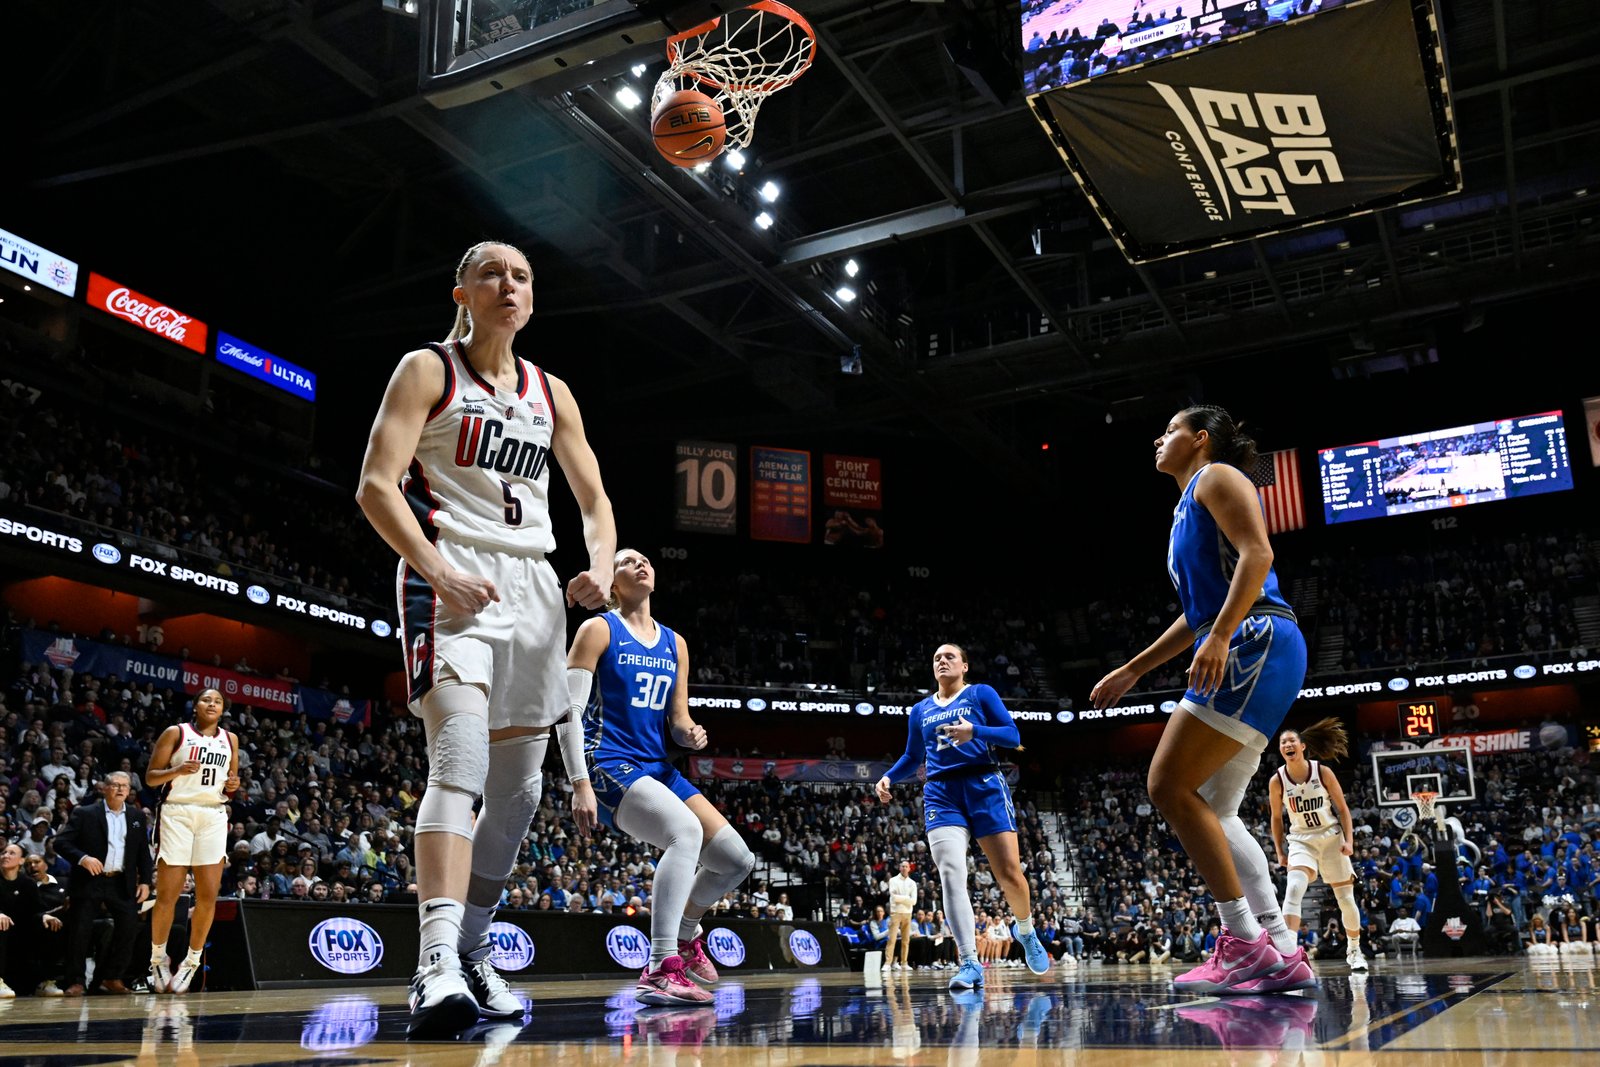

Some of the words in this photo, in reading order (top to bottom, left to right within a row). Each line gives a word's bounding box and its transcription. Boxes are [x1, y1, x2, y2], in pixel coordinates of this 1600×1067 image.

[1244, 1, 1257, 12] 42
[1175, 22, 1186, 32] 22
[1254, 93, 1344, 184] BIG
[1188, 87, 1296, 215] EAST
[1165, 130, 1223, 222] CONFERENCE
[106, 288, 191, 341] Coca-Cola
[219, 342, 263, 367] Michelob
[273, 364, 312, 391] ULTRA
[455, 415, 548, 481] UConn
[676, 445, 704, 457] BILLY
[707, 448, 735, 460] JOEL
[758, 461, 789, 471] ARENA
[791, 464, 803, 472] OF
[835, 459, 870, 472] FIGHT
[675, 458, 736, 510] 10
[760, 470, 777, 480] THE
[779, 472, 802, 481] YEAR
[826, 477, 880, 491] CENTURY
[851, 471, 867, 480] THE
[500, 479, 522, 526] 5
[1431, 516, 1458, 531] 112
[660, 546, 689, 560] 109
[0, 518, 82, 553] SPORTS
[99, 547, 114, 557] FOX
[130, 554, 167, 576] FOX
[170, 566, 239, 595] SPORTS
[252, 589, 265, 598] FOX
[277, 594, 307, 613] FOX
[309, 604, 366, 629] SPORTS
[907, 565, 930, 579] 110
[136, 624, 164, 646] 16
[618, 653, 677, 673] CREIGHTON
[126, 660, 178, 681] FOLLOW
[182, 671, 199, 686] US
[204, 675, 220, 689] ON
[242, 683, 299, 705] @BIGEAST
[1297, 688, 1323, 699] FOX
[1325, 682, 1382, 696] SPORTS
[1415, 675, 1445, 687] FOX
[1447, 669, 1507, 684] SPORTS
[1542, 662, 1575, 675] FOX
[630, 671, 672, 710] 30
[688, 697, 741, 709] SPORTS
[772, 701, 797, 711] FOX
[799, 702, 851, 713] SPORTS
[879, 705, 904, 715] FOX
[1008, 711, 1052, 721] SPORTS
[1079, 709, 1104, 720] FOX
[1105, 704, 1155, 718] SPORTS
[1409, 705, 1433, 716] 7:01
[1452, 704, 1480, 721] 20
[922, 707, 972, 728] CREIGHTON
[1407, 716, 1433, 736] 24
[935, 720, 960, 752] 2
[1474, 731, 1531, 752] SHINE
[189, 746, 227, 767] UConn
[201, 768, 216, 786] 21
[1289, 796, 1323, 813] UConn
[1303, 811, 1321, 828] 20
[324, 929, 368, 952] FOX
[489, 932, 523, 951] FOX
[615, 935, 642, 952] FOX
[714, 936, 737, 951] FOX
[795, 937, 814, 951] FOX
[328, 952, 370, 961] SPORTS
[619, 952, 645, 960] SPORTS
